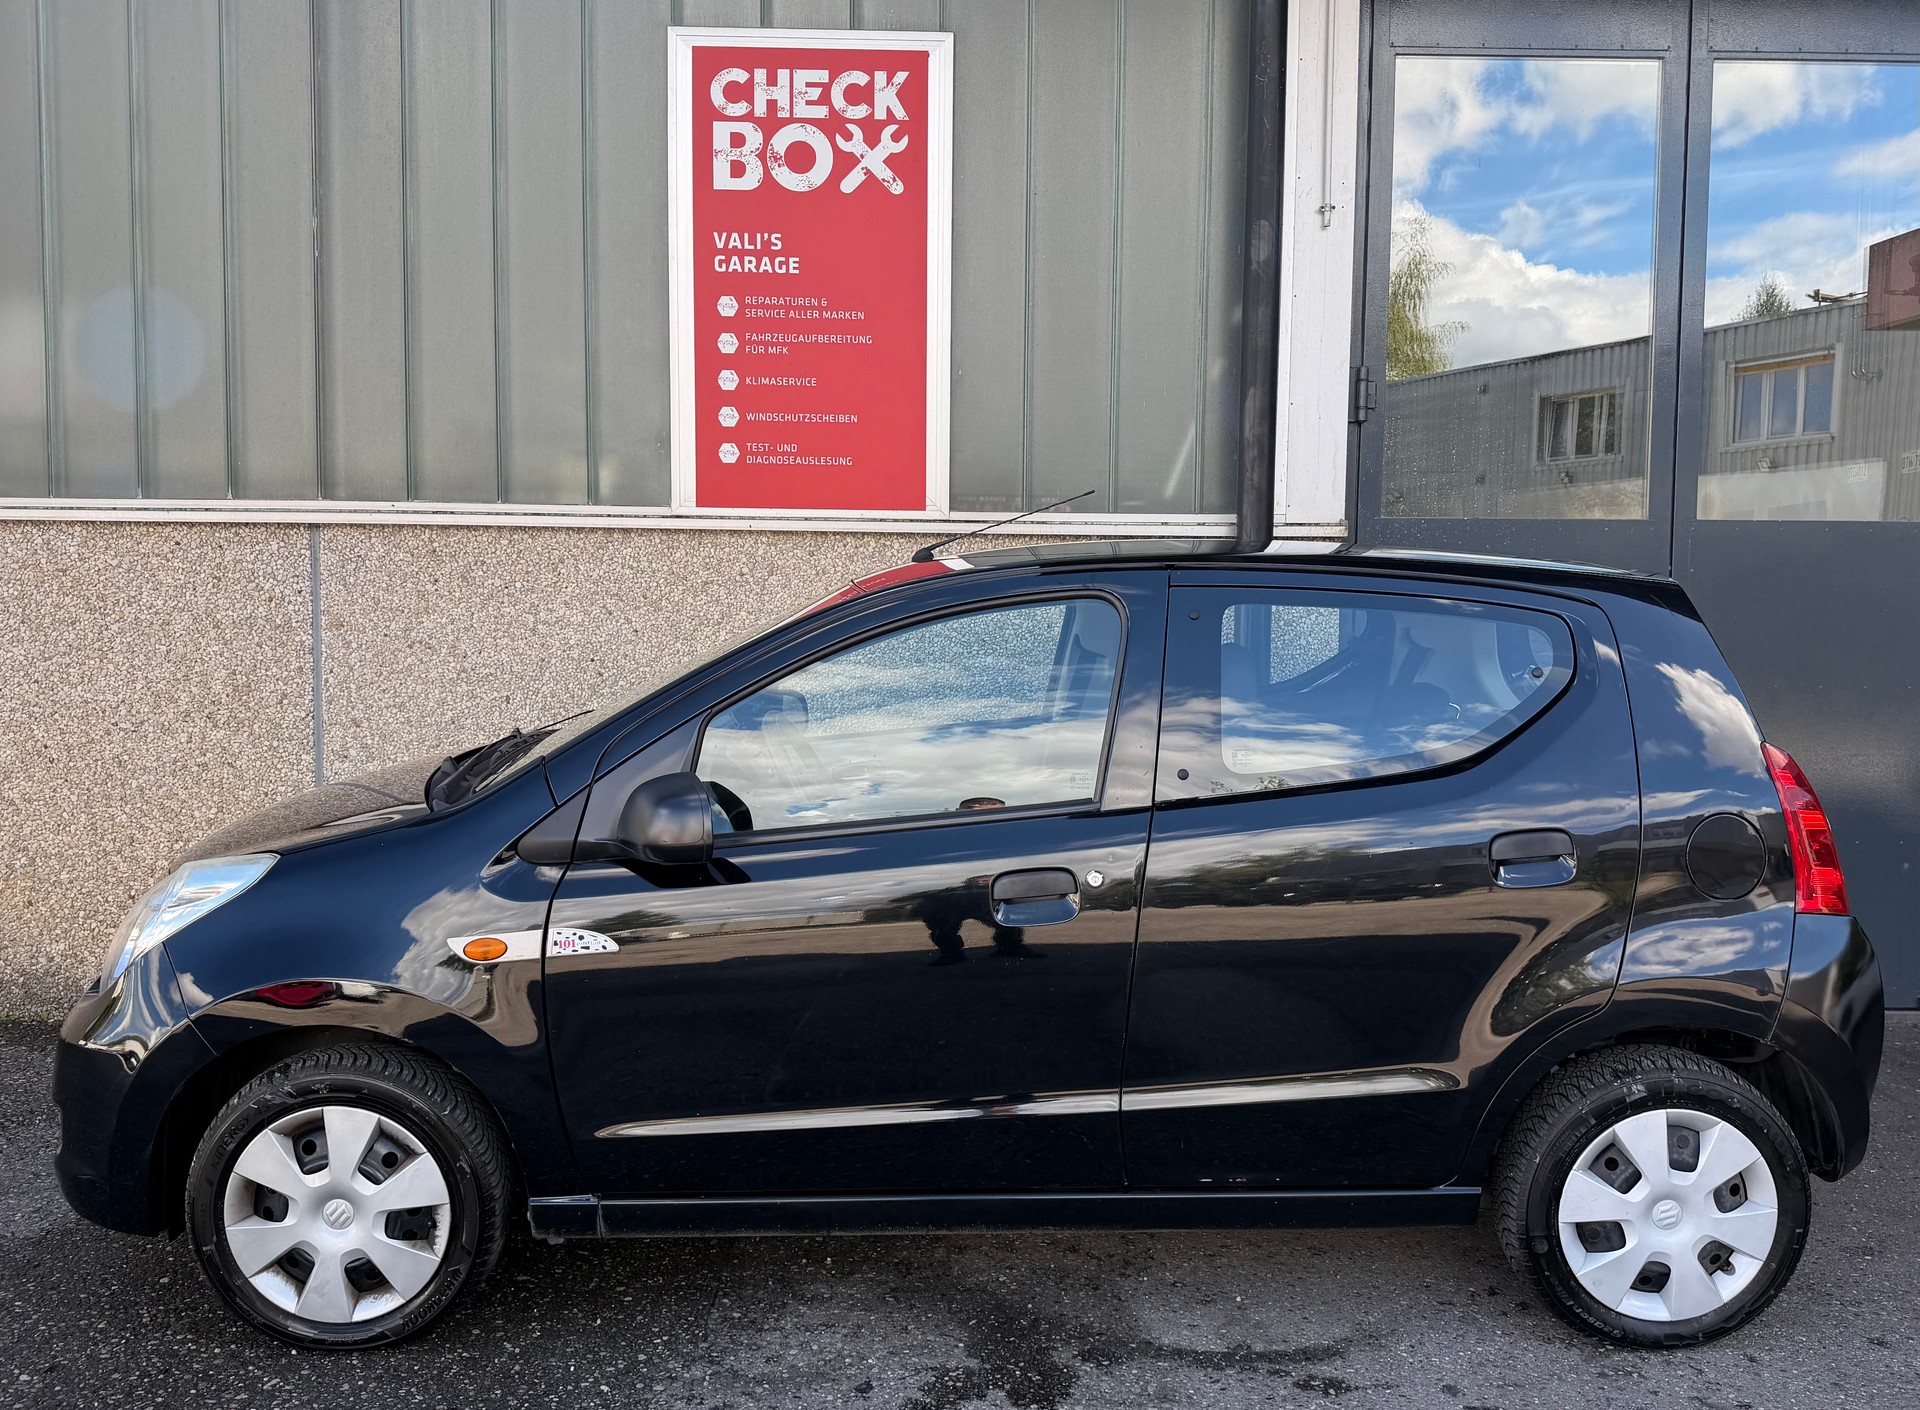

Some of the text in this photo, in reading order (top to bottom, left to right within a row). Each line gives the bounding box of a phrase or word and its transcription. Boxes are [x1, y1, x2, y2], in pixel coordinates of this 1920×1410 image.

[710, 67, 909, 120] CHECK
[713, 121, 909, 195] BOX
[714, 255, 799, 274] GARAGE
[745, 296, 828, 307] REPARATUREN &
[745, 309, 864, 320] SERVICE ALLER MARKEN
[745, 332, 872, 344] FAHRZEUGAUFBEREITUNG
[745, 344, 789, 355] FÜR MFK
[745, 376, 817, 387] KLIMASERVICE
[745, 412, 858, 423] WINDSCHUTZSCHEIBEN
[746, 442, 798, 453] TEST- UND
[746, 455, 853, 466] DIAGNOSEAUSLESUNG
[559, 939, 576, 948] 101
